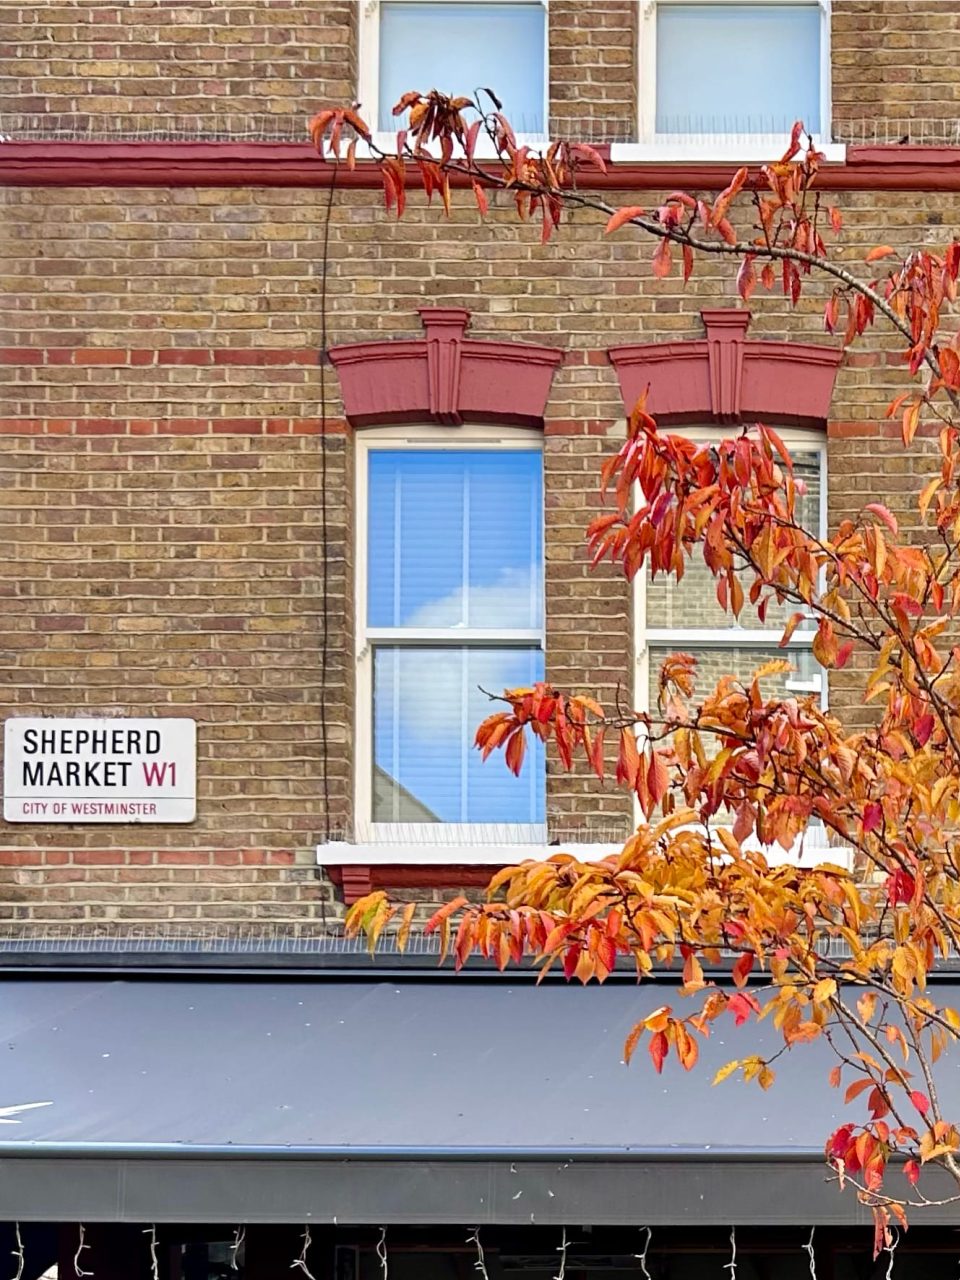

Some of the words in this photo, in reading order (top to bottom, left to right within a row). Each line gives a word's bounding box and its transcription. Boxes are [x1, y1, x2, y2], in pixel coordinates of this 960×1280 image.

[23, 729, 161, 754] SHEPHERD
[23, 761, 132, 786] MARKET
[142, 761, 176, 787] W1
[22, 802, 48, 815] CITY
[53, 803, 68, 815] OF
[71, 803, 157, 815] WESTMINSTER
